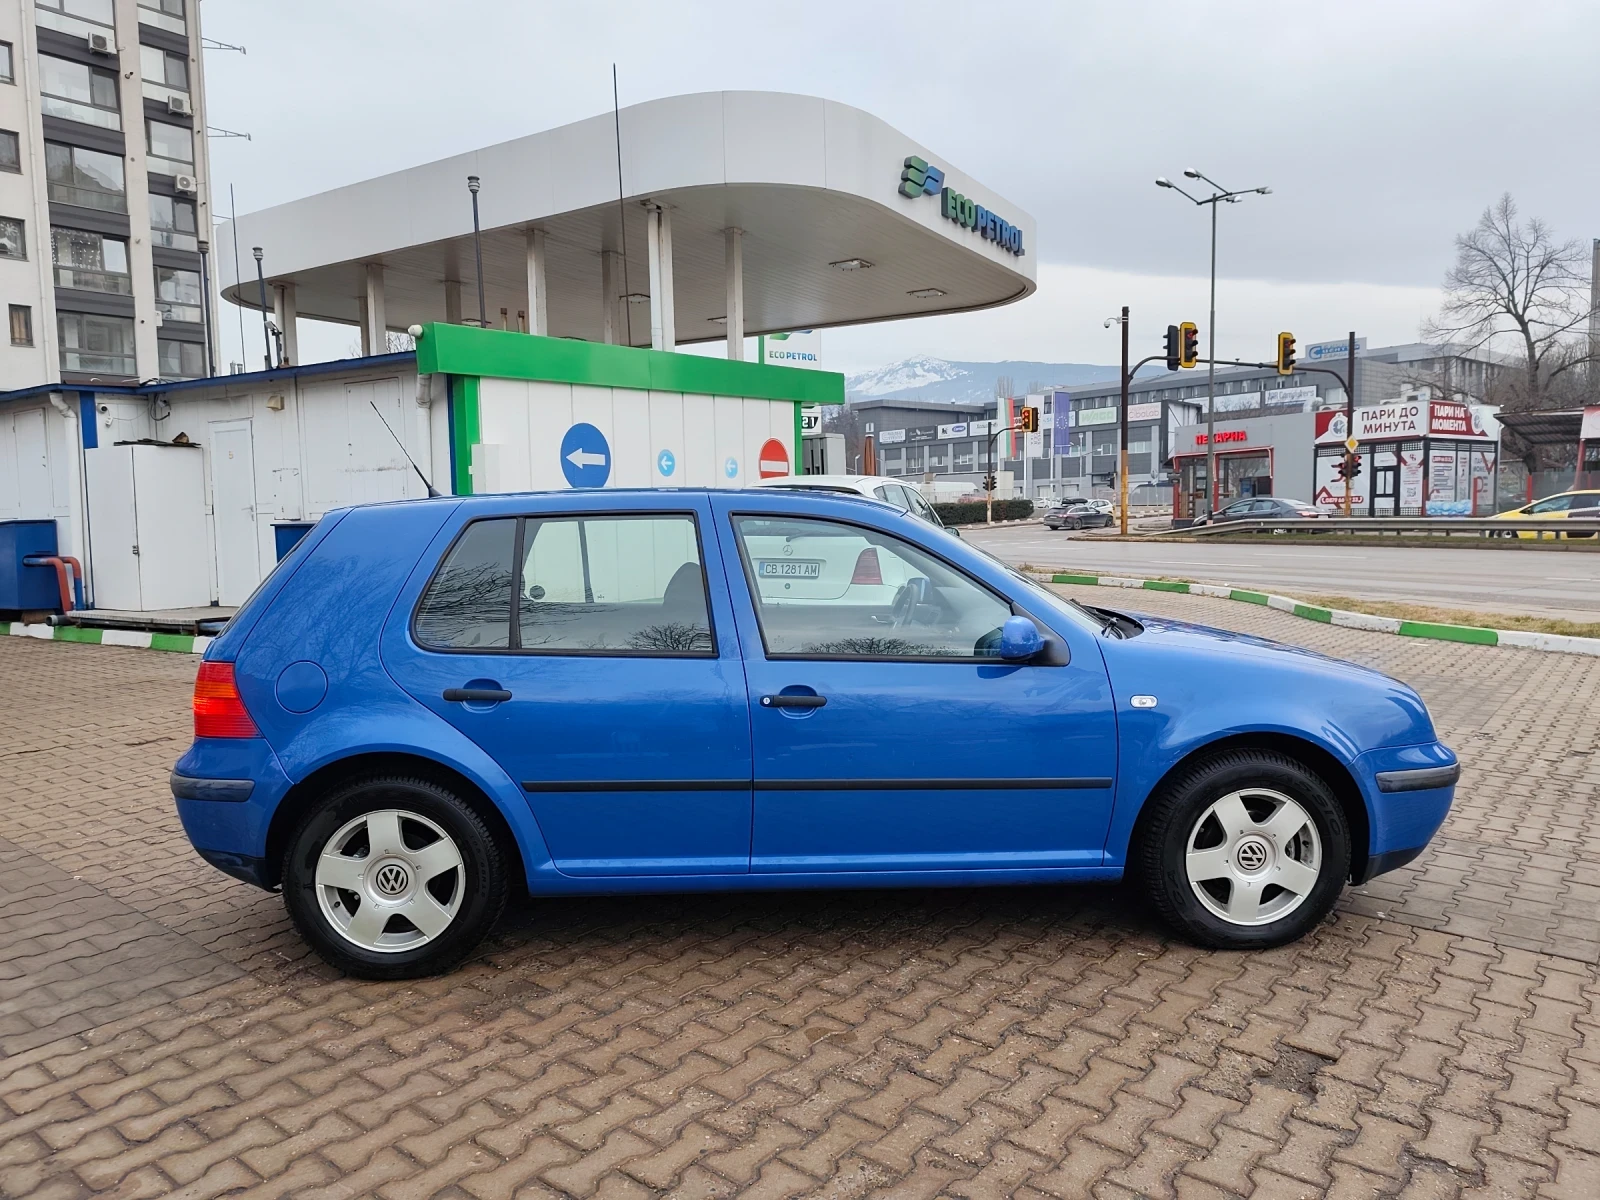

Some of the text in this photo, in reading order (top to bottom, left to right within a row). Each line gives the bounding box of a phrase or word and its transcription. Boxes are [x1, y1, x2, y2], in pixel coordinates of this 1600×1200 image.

[1361, 406, 1419, 422] ПАРИ ДО
[1434, 404, 1465, 418] ПАРИ НА
[1363, 420, 1416, 434] МИНУТА
[1431, 418, 1467, 431] МОМЕНТА
[1195, 430, 1247, 445] ПЕАРНА
[765, 563, 817, 576] CB 1281 AM
